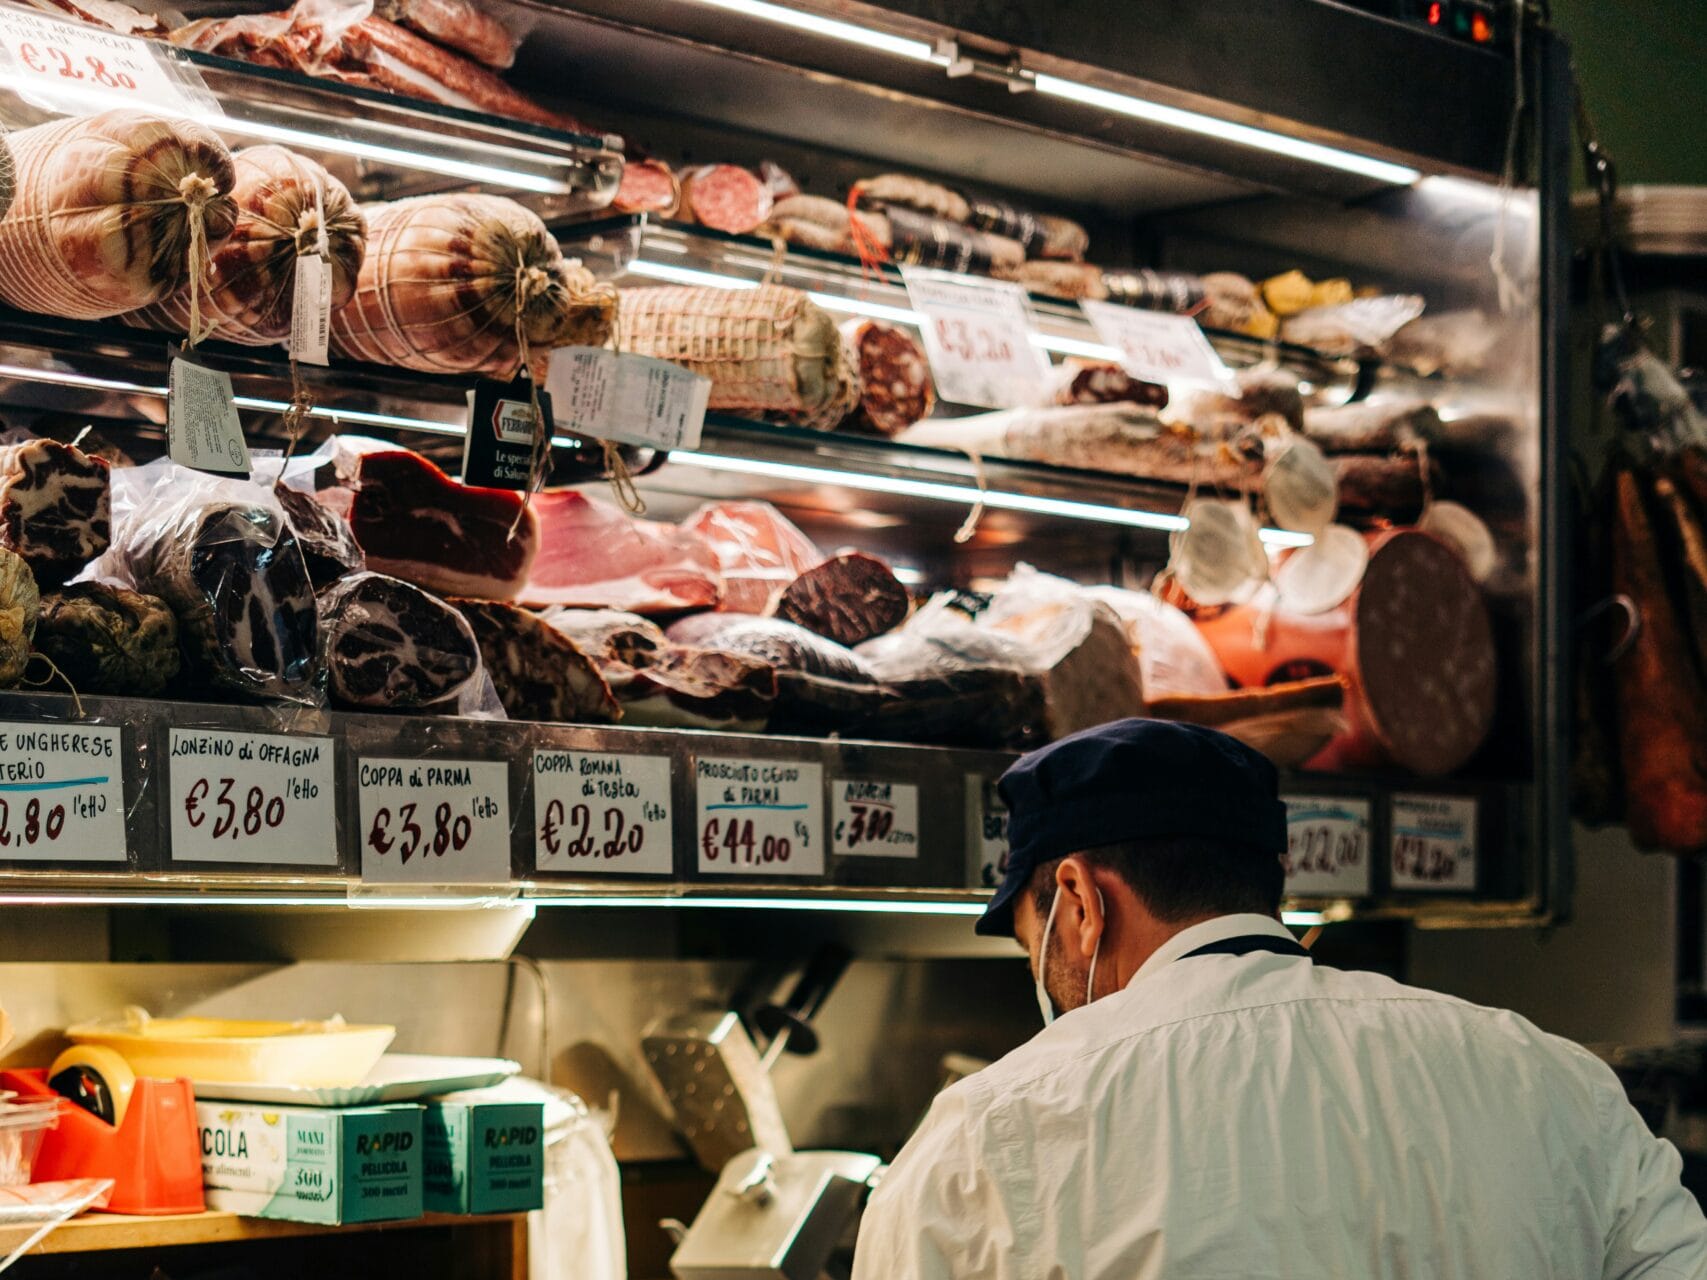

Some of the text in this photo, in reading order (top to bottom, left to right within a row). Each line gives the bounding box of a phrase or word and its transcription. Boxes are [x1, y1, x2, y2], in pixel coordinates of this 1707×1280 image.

[16, 732, 113, 757] UNGHERESE
[238, 741, 254, 760] di
[259, 743, 320, 767] OFFAGNA
[360, 764, 472, 788] COPPA di PARMA
[536, 754, 622, 776] COPPA ROMANA
[286, 777, 319, 800] l'etto
[582, 778, 595, 797] di
[73, 794, 107, 818] l'etto
[472, 796, 498, 819] l'etto
[298, 1130, 324, 1145] MAXI
[356, 1131, 413, 1157] RAPID
[484, 1126, 537, 1149] RAPID
[361, 1161, 408, 1177] PELLICOLA
